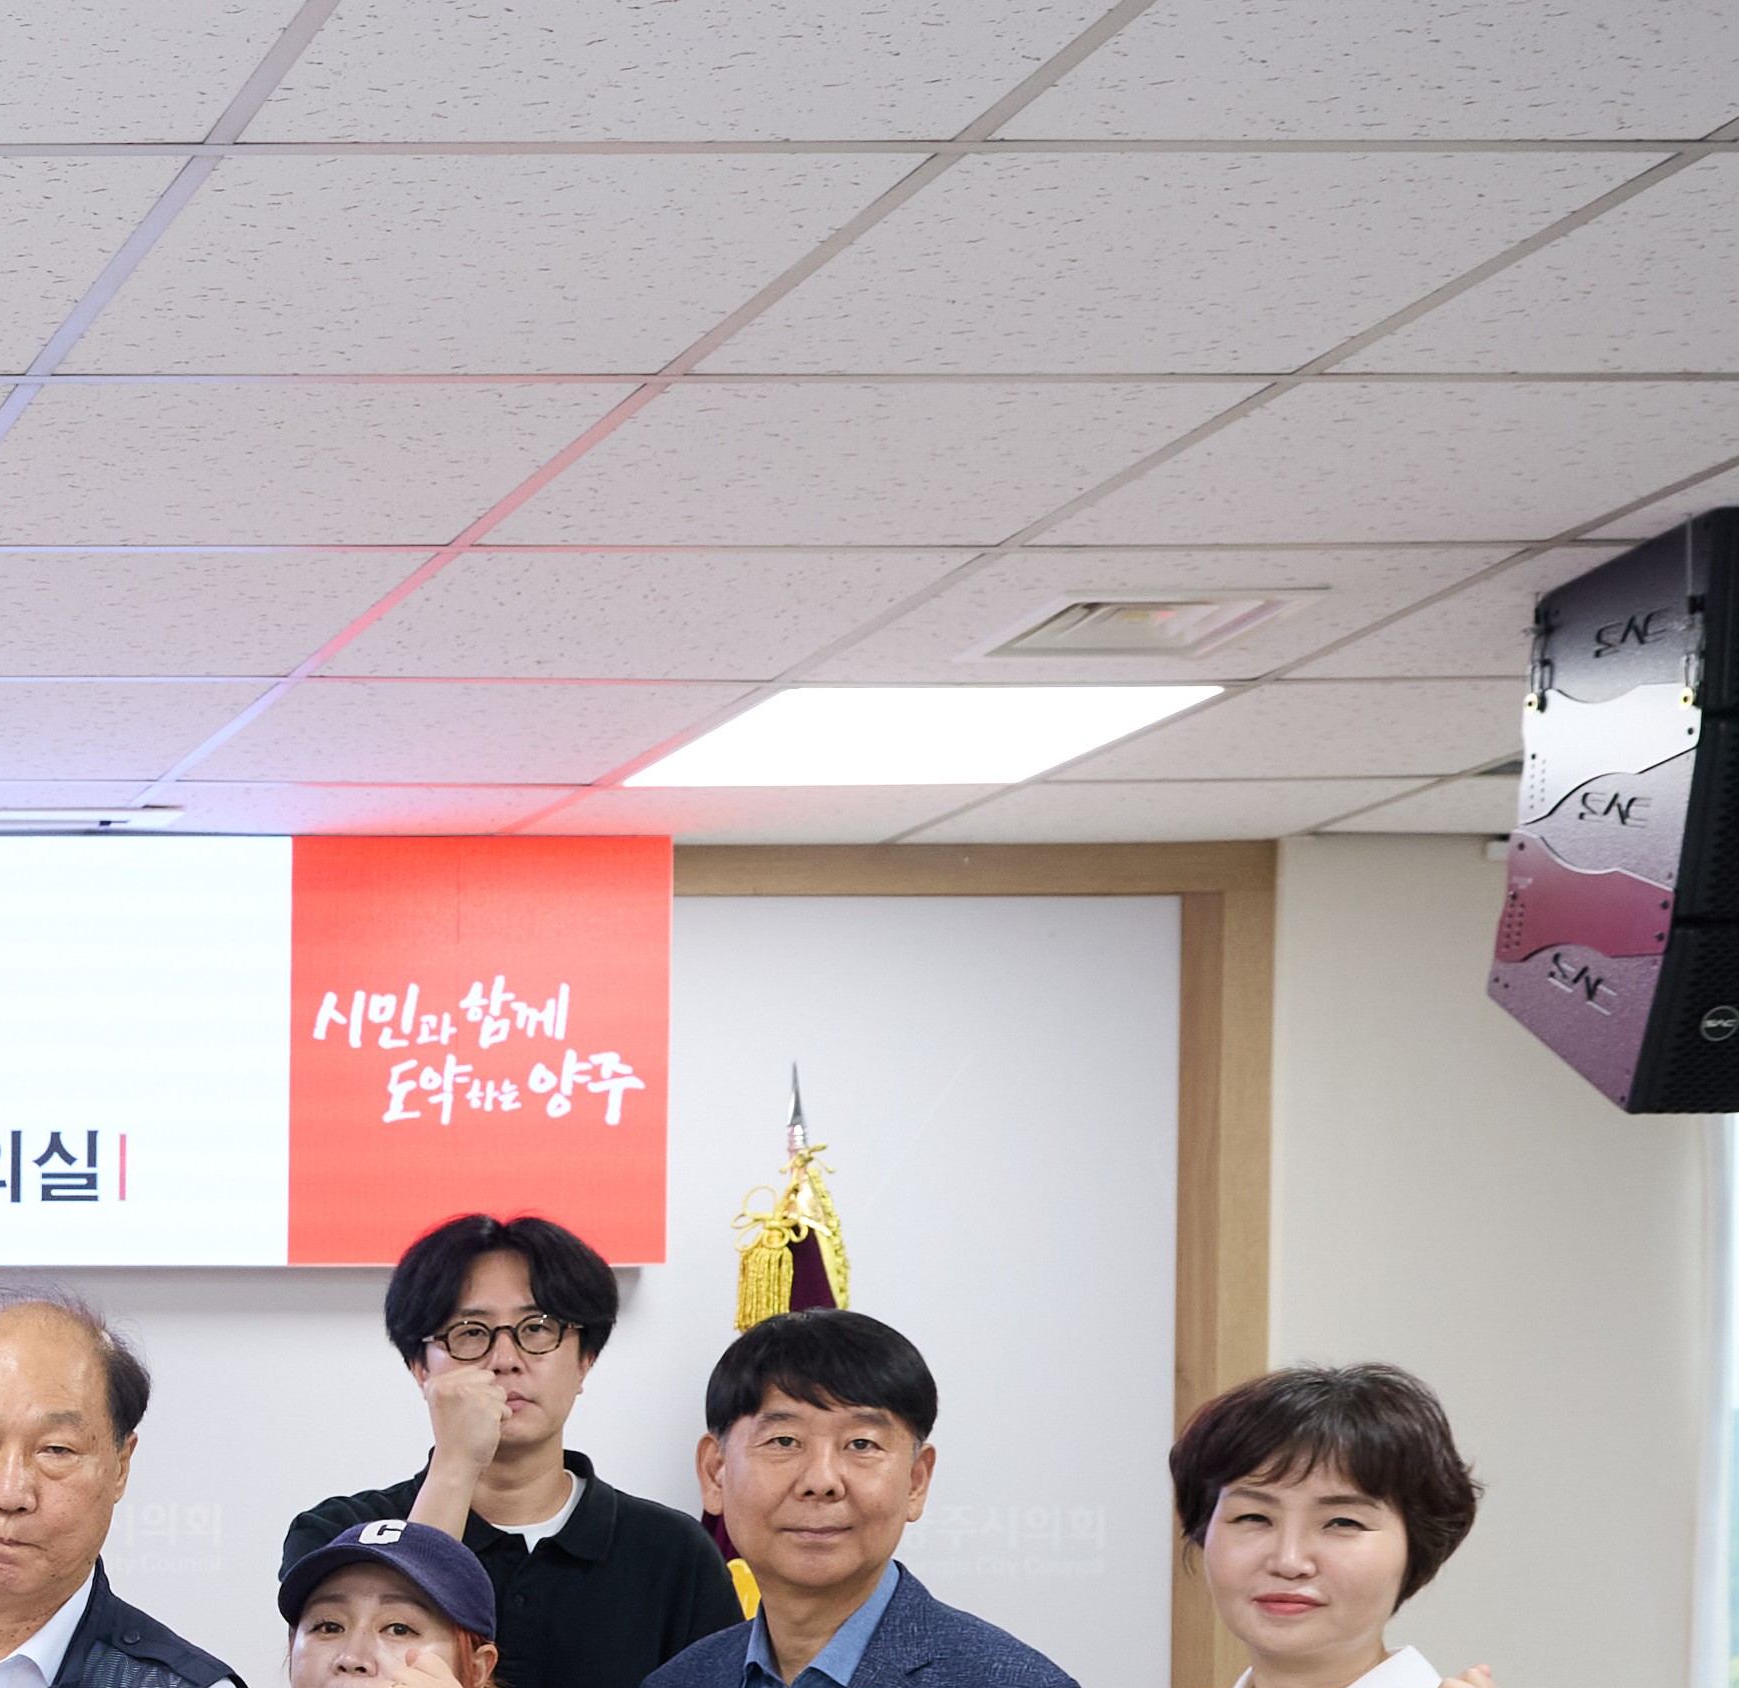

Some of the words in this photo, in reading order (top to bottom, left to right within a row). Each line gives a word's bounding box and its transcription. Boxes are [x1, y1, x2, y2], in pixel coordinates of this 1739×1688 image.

[312, 982, 458, 1050] 시민과
[459, 974, 571, 1050] 함께
[382, 1053, 523, 1126] 도약하는
[527, 1048, 647, 1126] 양주
